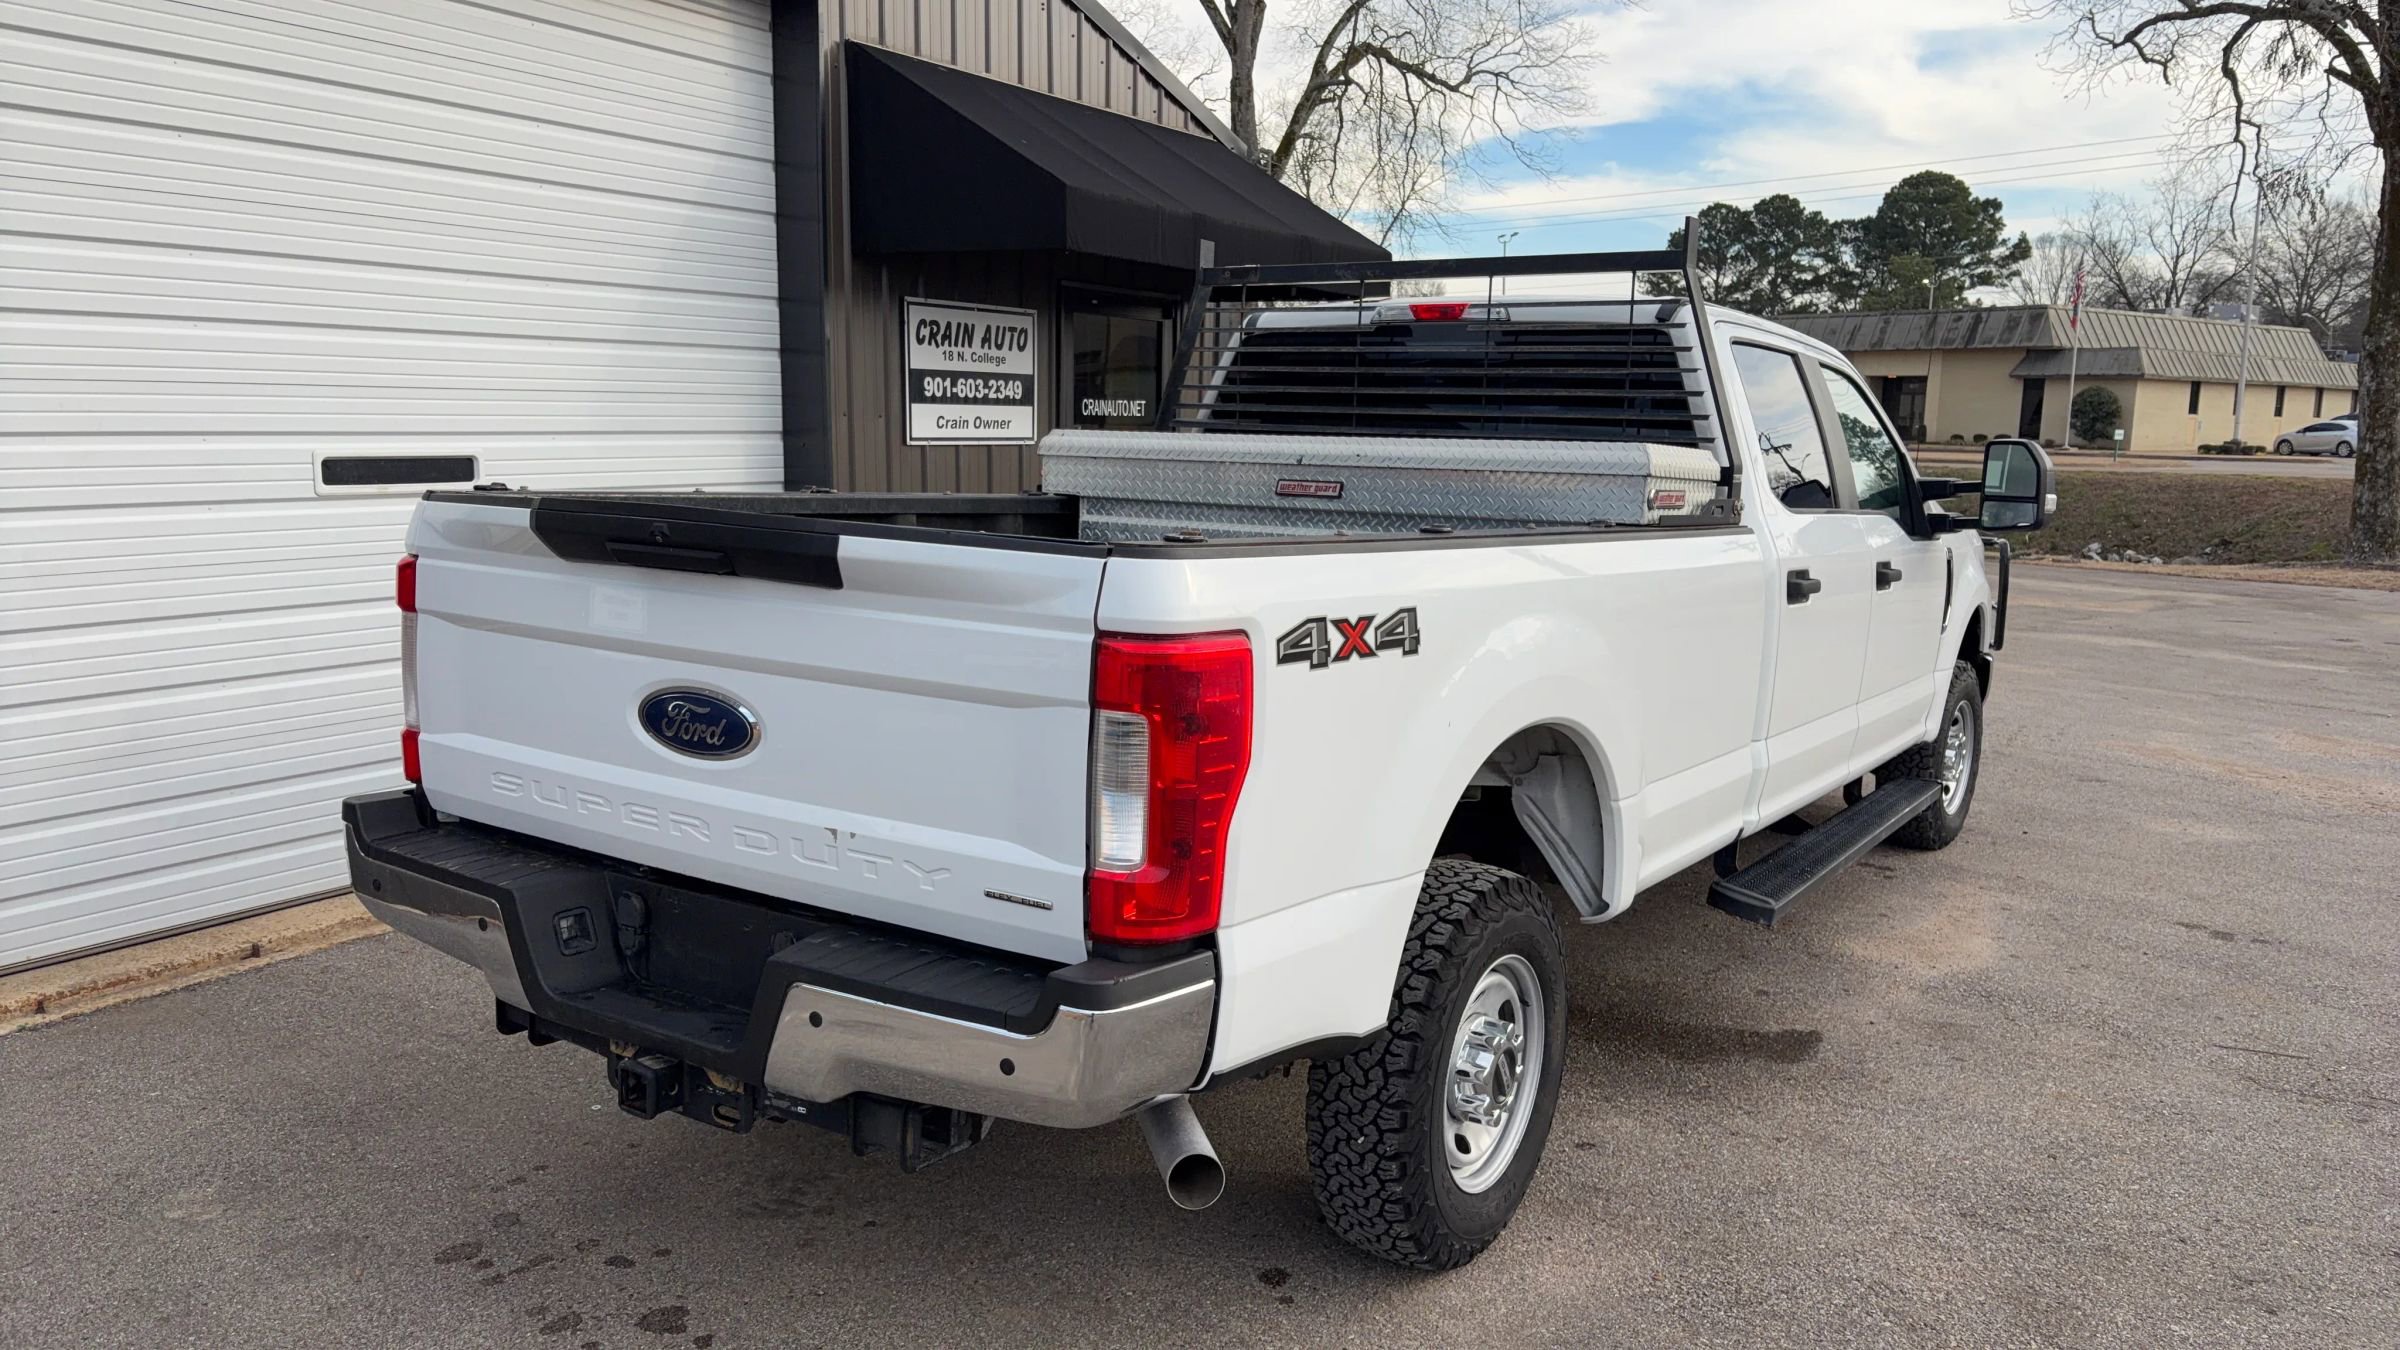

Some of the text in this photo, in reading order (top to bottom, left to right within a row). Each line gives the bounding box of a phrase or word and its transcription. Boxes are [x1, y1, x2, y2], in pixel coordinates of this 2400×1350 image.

[915, 318, 1029, 353] CRAIN AUTO
[942, 350, 1007, 367] 18 N. College
[923, 376, 1023, 400] 901-603-2349
[1081, 398, 1147, 417] CRAINAUTO.NET
[936, 415, 1012, 430] Crain Owner
[661, 701, 727, 746] Ford
[490, 771, 951, 891] SUPER DUTY
